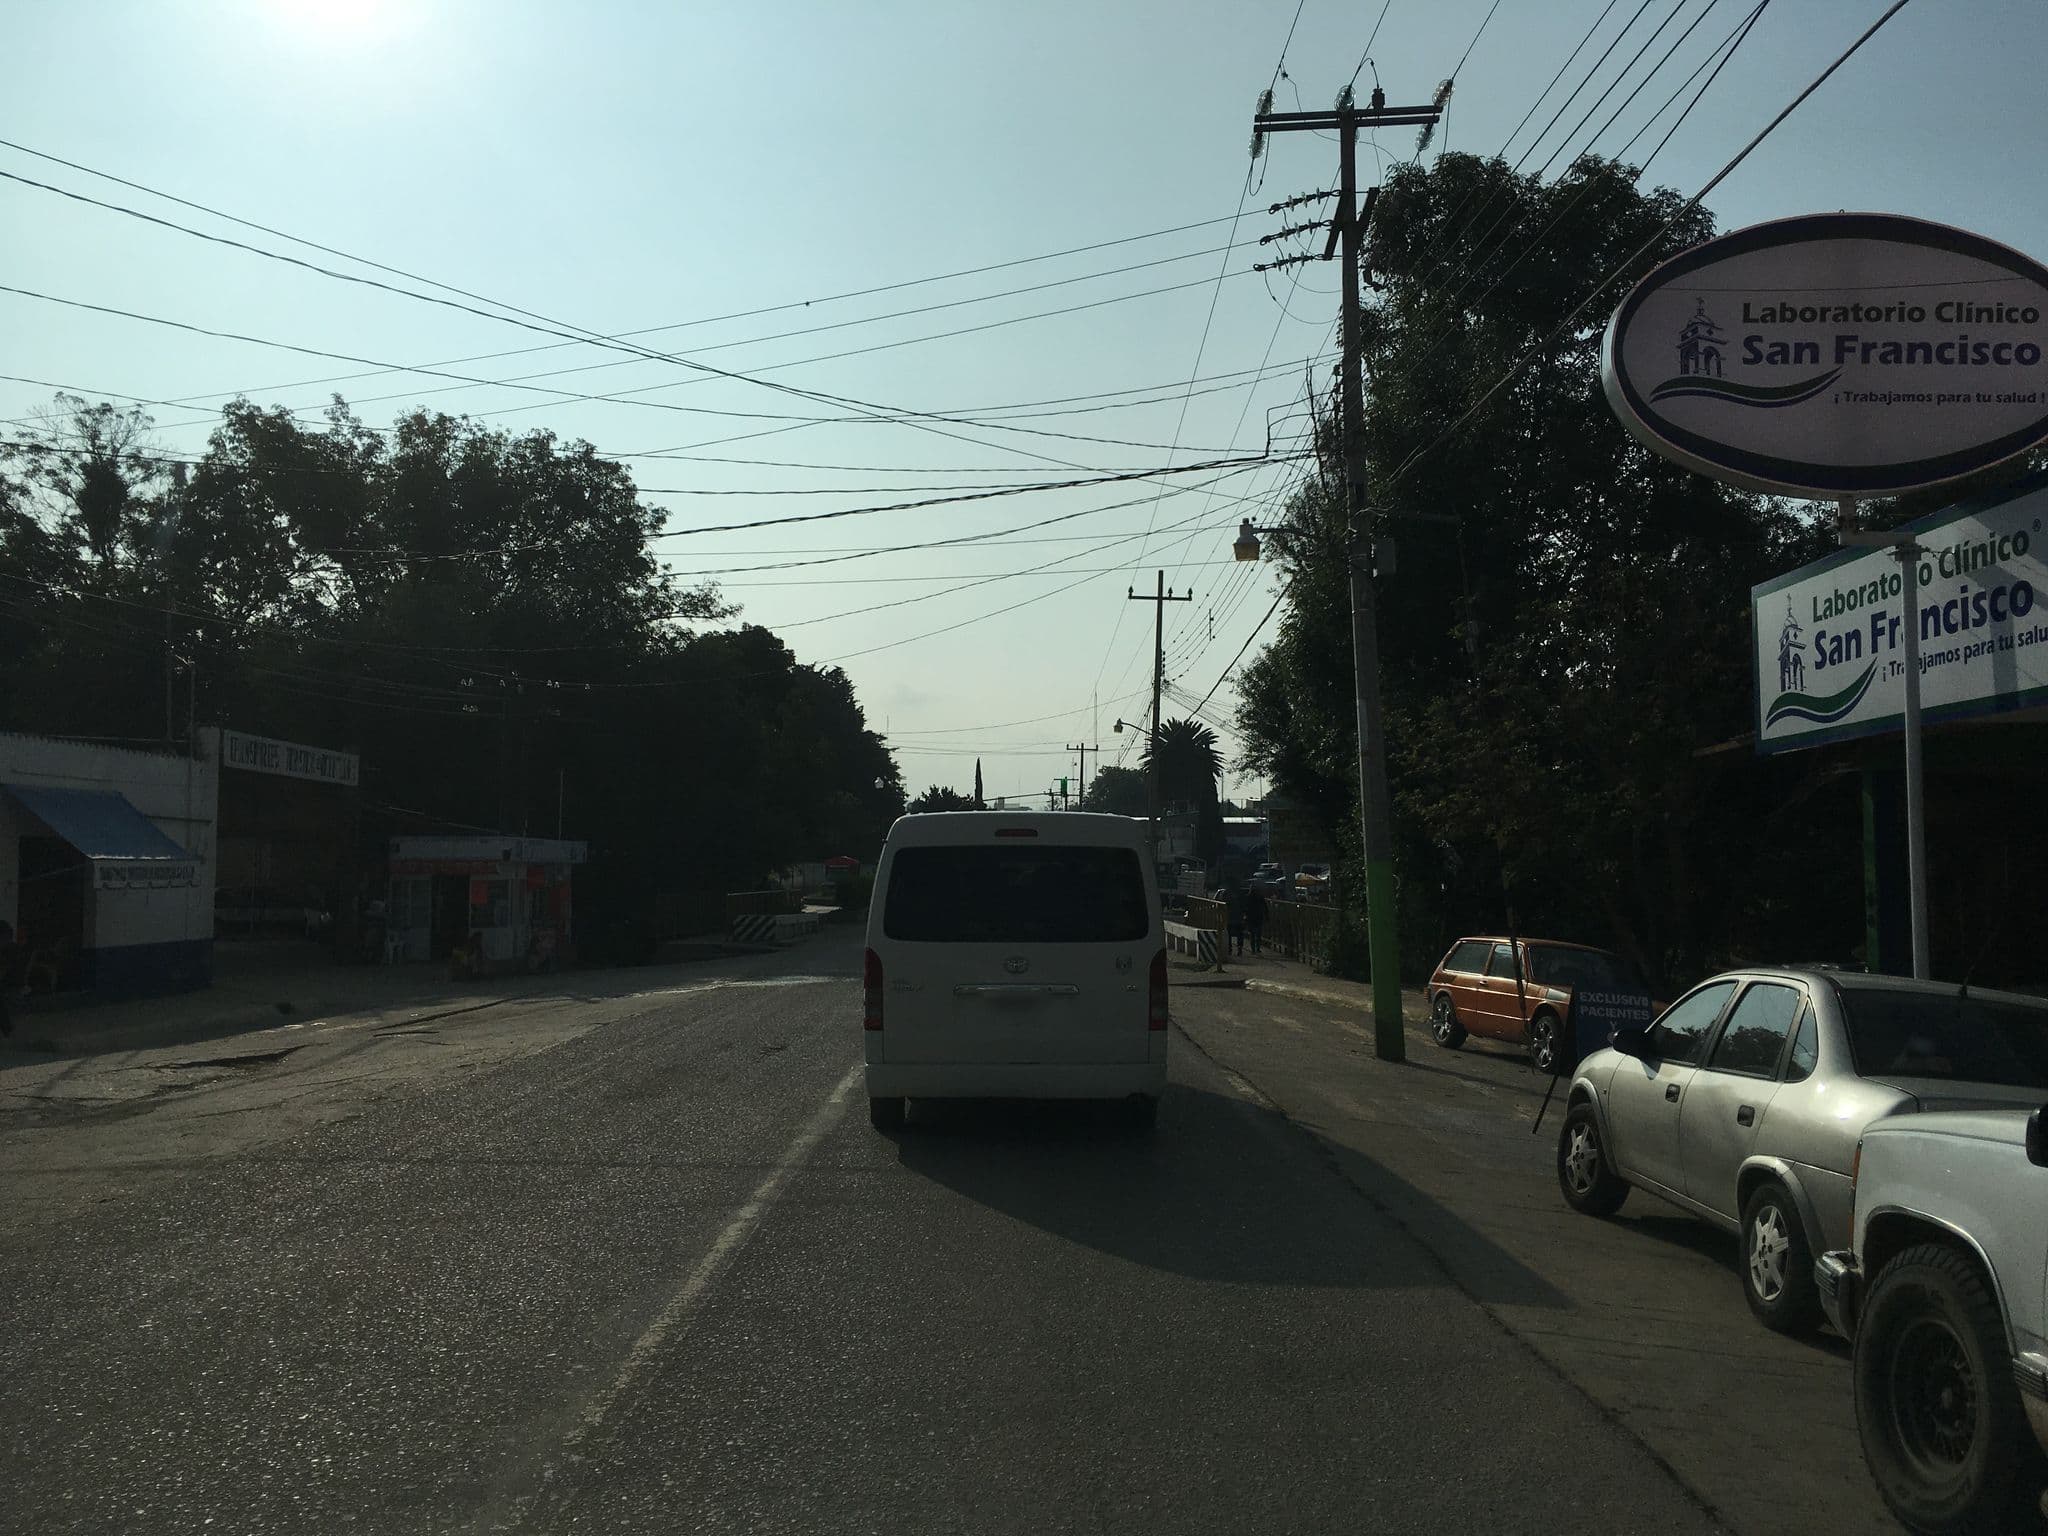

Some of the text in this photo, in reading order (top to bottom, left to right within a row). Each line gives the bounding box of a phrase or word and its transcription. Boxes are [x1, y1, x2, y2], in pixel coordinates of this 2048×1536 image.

[1743, 301, 2040, 324] Laboratorio Clínico
[1742, 334, 2041, 366] San Francisco
[1936, 393, 1972, 406] para
[1975, 392, 1992, 404] tu
[1995, 391, 2037, 404] salud
[1813, 529, 2030, 623] Laboratoo Clínico
[1813, 580, 2034, 671] San Frncisco
[1963, 639, 1995, 665] para
[1998, 633, 2015, 651] tu
[2017, 625, 2048, 648] salu
[1580, 1005, 1650, 1020] PACIENTES
